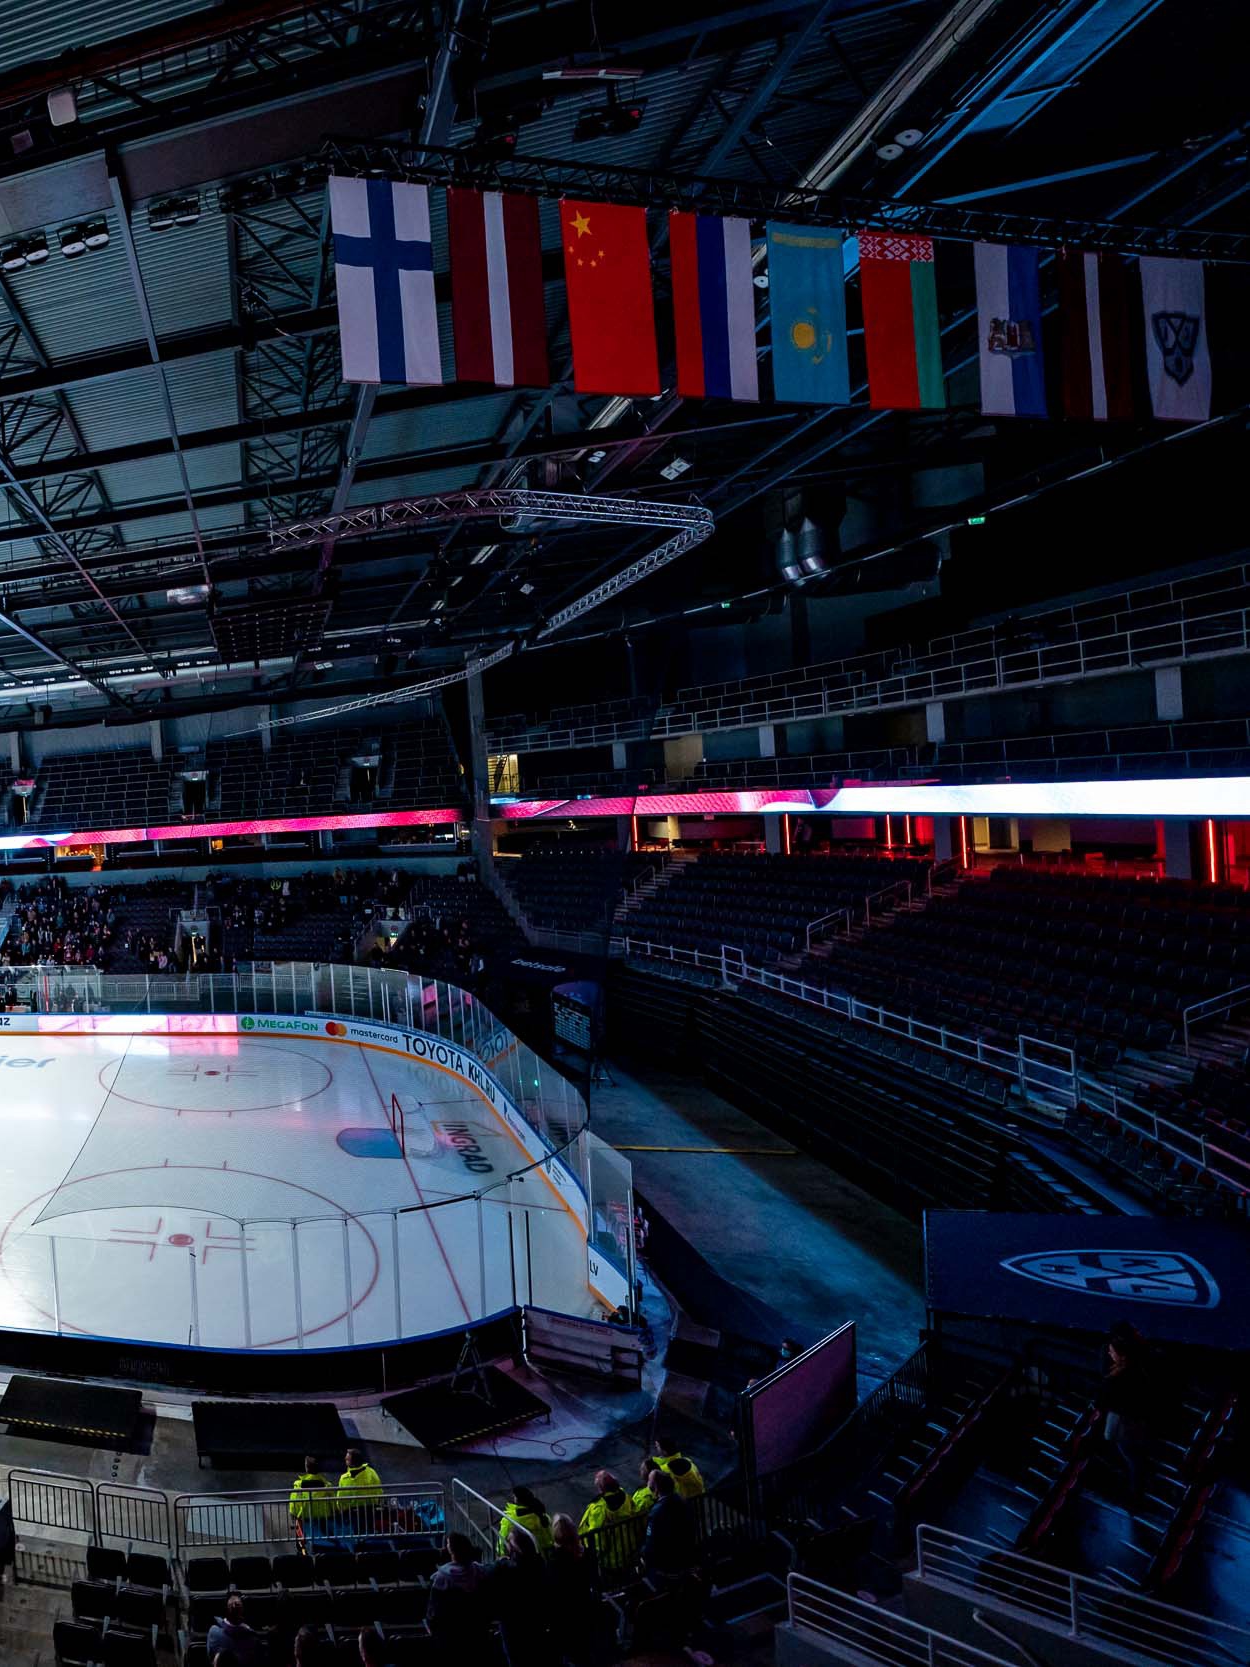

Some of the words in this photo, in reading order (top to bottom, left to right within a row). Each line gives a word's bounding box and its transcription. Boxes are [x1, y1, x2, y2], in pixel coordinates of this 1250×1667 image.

[351, 1028, 398, 1044] mastercard
[402, 1034, 465, 1075] TOYOTA
[442, 1124, 495, 1173] INGRAD
